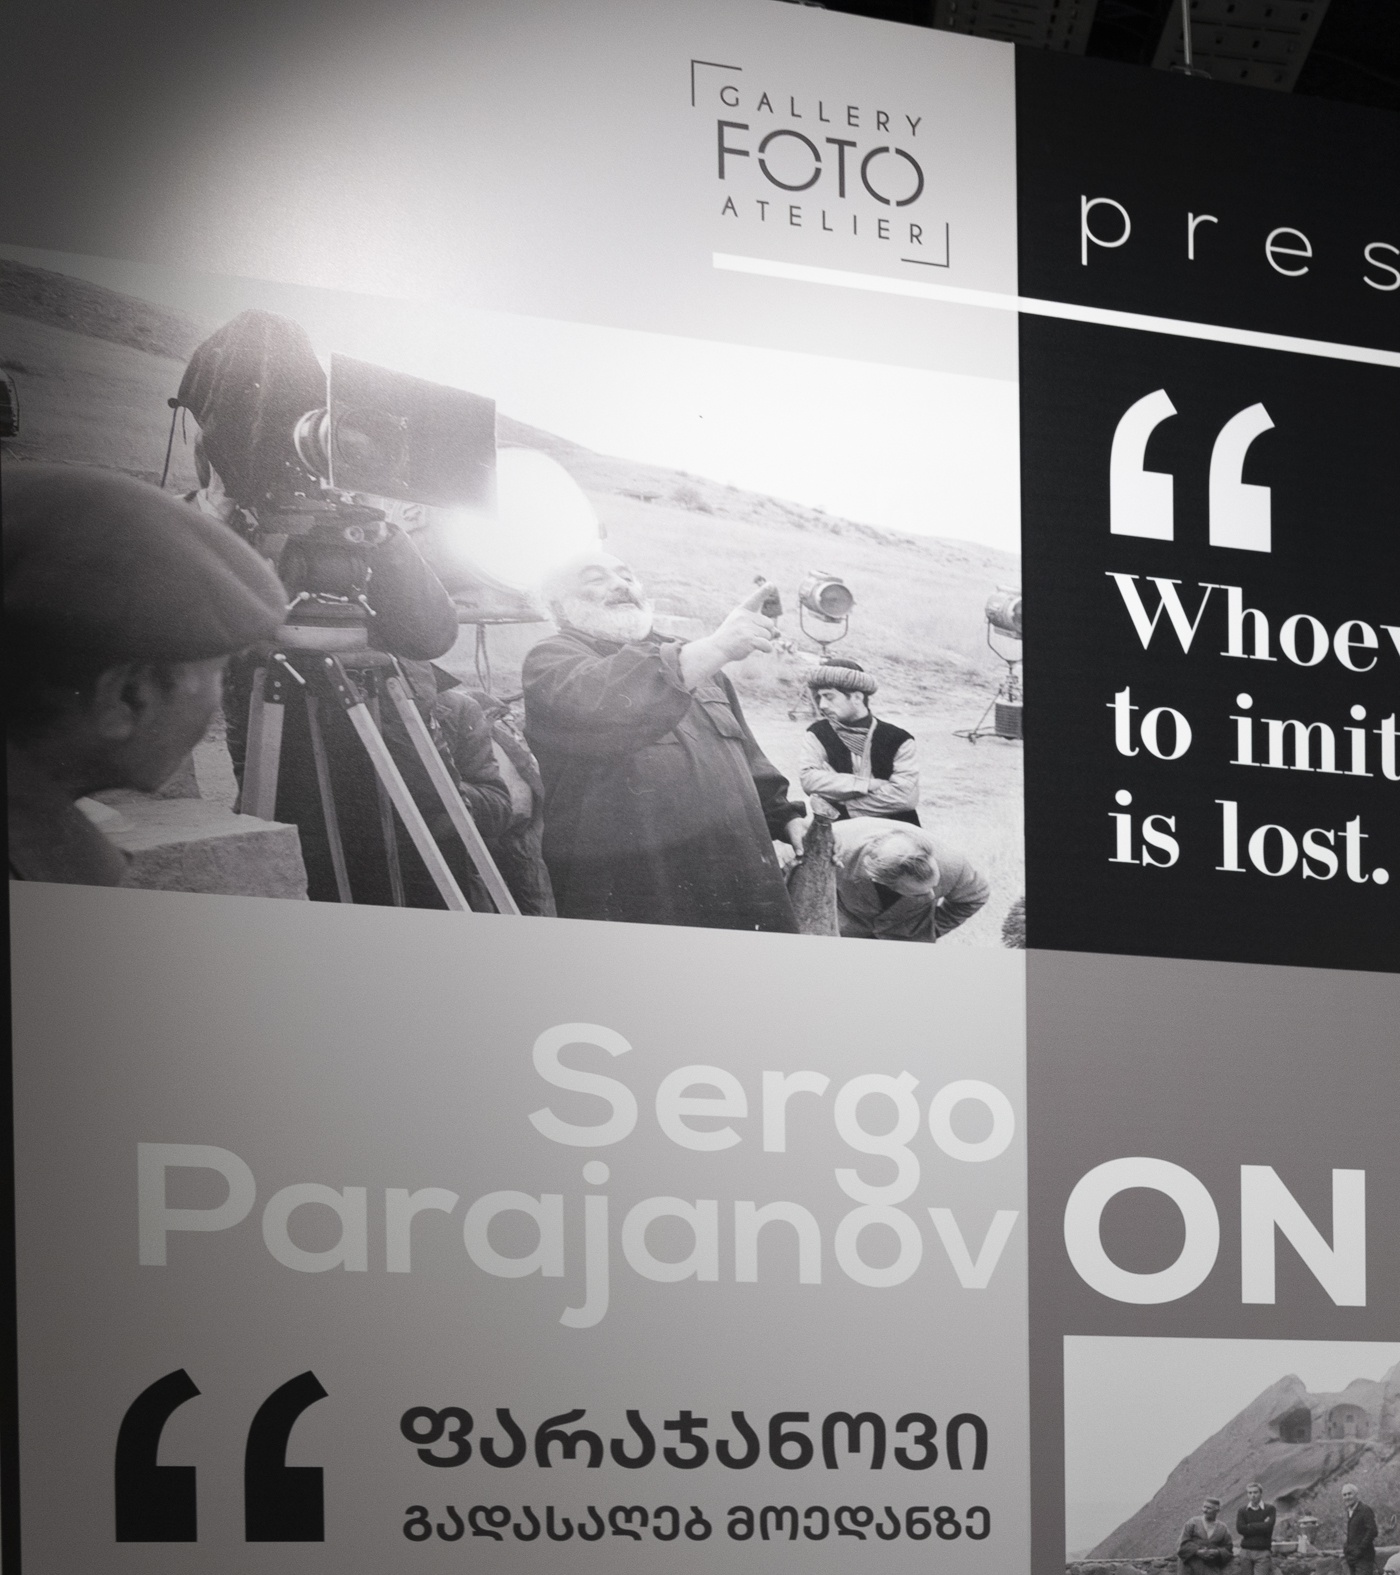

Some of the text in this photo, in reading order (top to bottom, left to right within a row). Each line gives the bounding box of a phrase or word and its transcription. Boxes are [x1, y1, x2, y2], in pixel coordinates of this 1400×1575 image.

[719, 85, 922, 137] GALLERY
[716, 118, 925, 208] FOTO
[720, 195, 923, 245] ATELIER
[1107, 687, 1192, 759] to
[1109, 790, 1389, 884] is lost.
[527, 1022, 1017, 1201] Sergo
[135, 1143, 1020, 1328] Parajanov
[1064, 1157, 1366, 1306] ON
